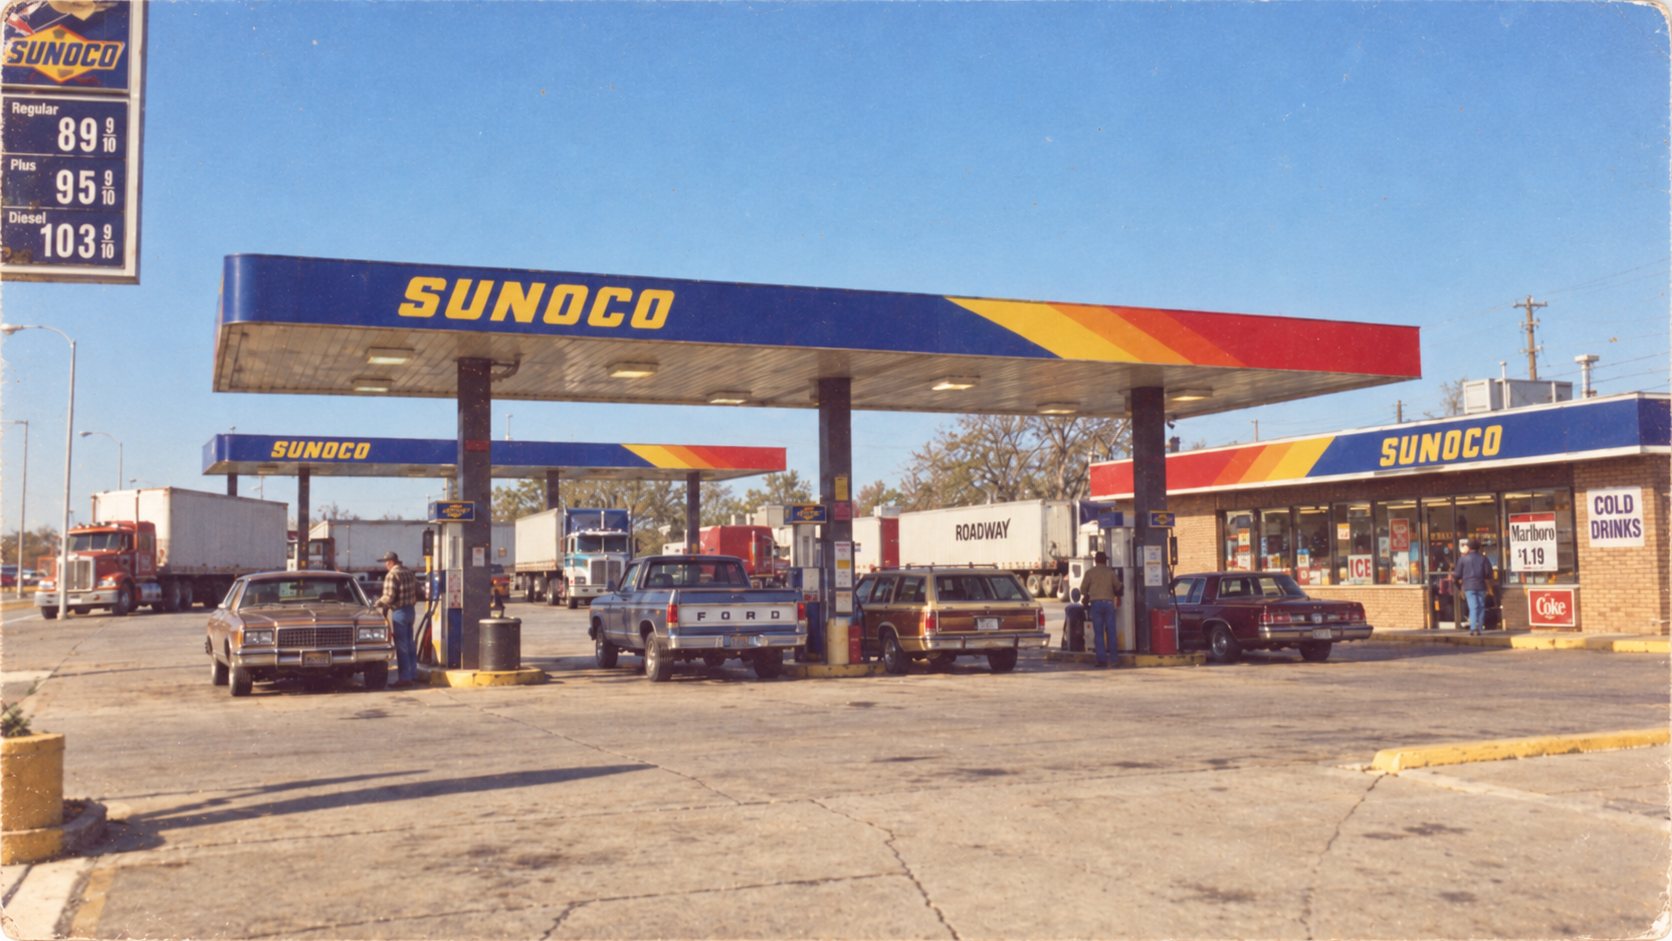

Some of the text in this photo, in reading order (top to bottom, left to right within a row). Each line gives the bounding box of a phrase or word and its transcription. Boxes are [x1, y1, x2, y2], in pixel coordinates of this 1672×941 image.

[7, 40, 119, 67] SUNOCO
[12, 102, 59, 116] Regular
[57, 117, 117, 153] 89 9 10
[10, 159, 37, 172] Plus
[56, 169, 116, 206] 95 9 10
[8, 212, 47, 225] Diesel
[40, 223, 115, 259] 103 9 10
[398, 276, 675, 330] SUNOCO
[271, 441, 371, 460] SUNOCO
[1379, 425, 1503, 467] SUNOCO
[1594, 494, 1634, 515] COLD
[955, 517, 1011, 541] ROADWAY
[1511, 524, 1555, 542] Marlboro
[1591, 518, 1642, 539] DRINKS
[1518, 547, 1545, 566] $1.19
[1349, 558, 1372, 578] ICE
[697, 611, 780, 621] FORD
[1535, 596, 1567, 617] Coke
